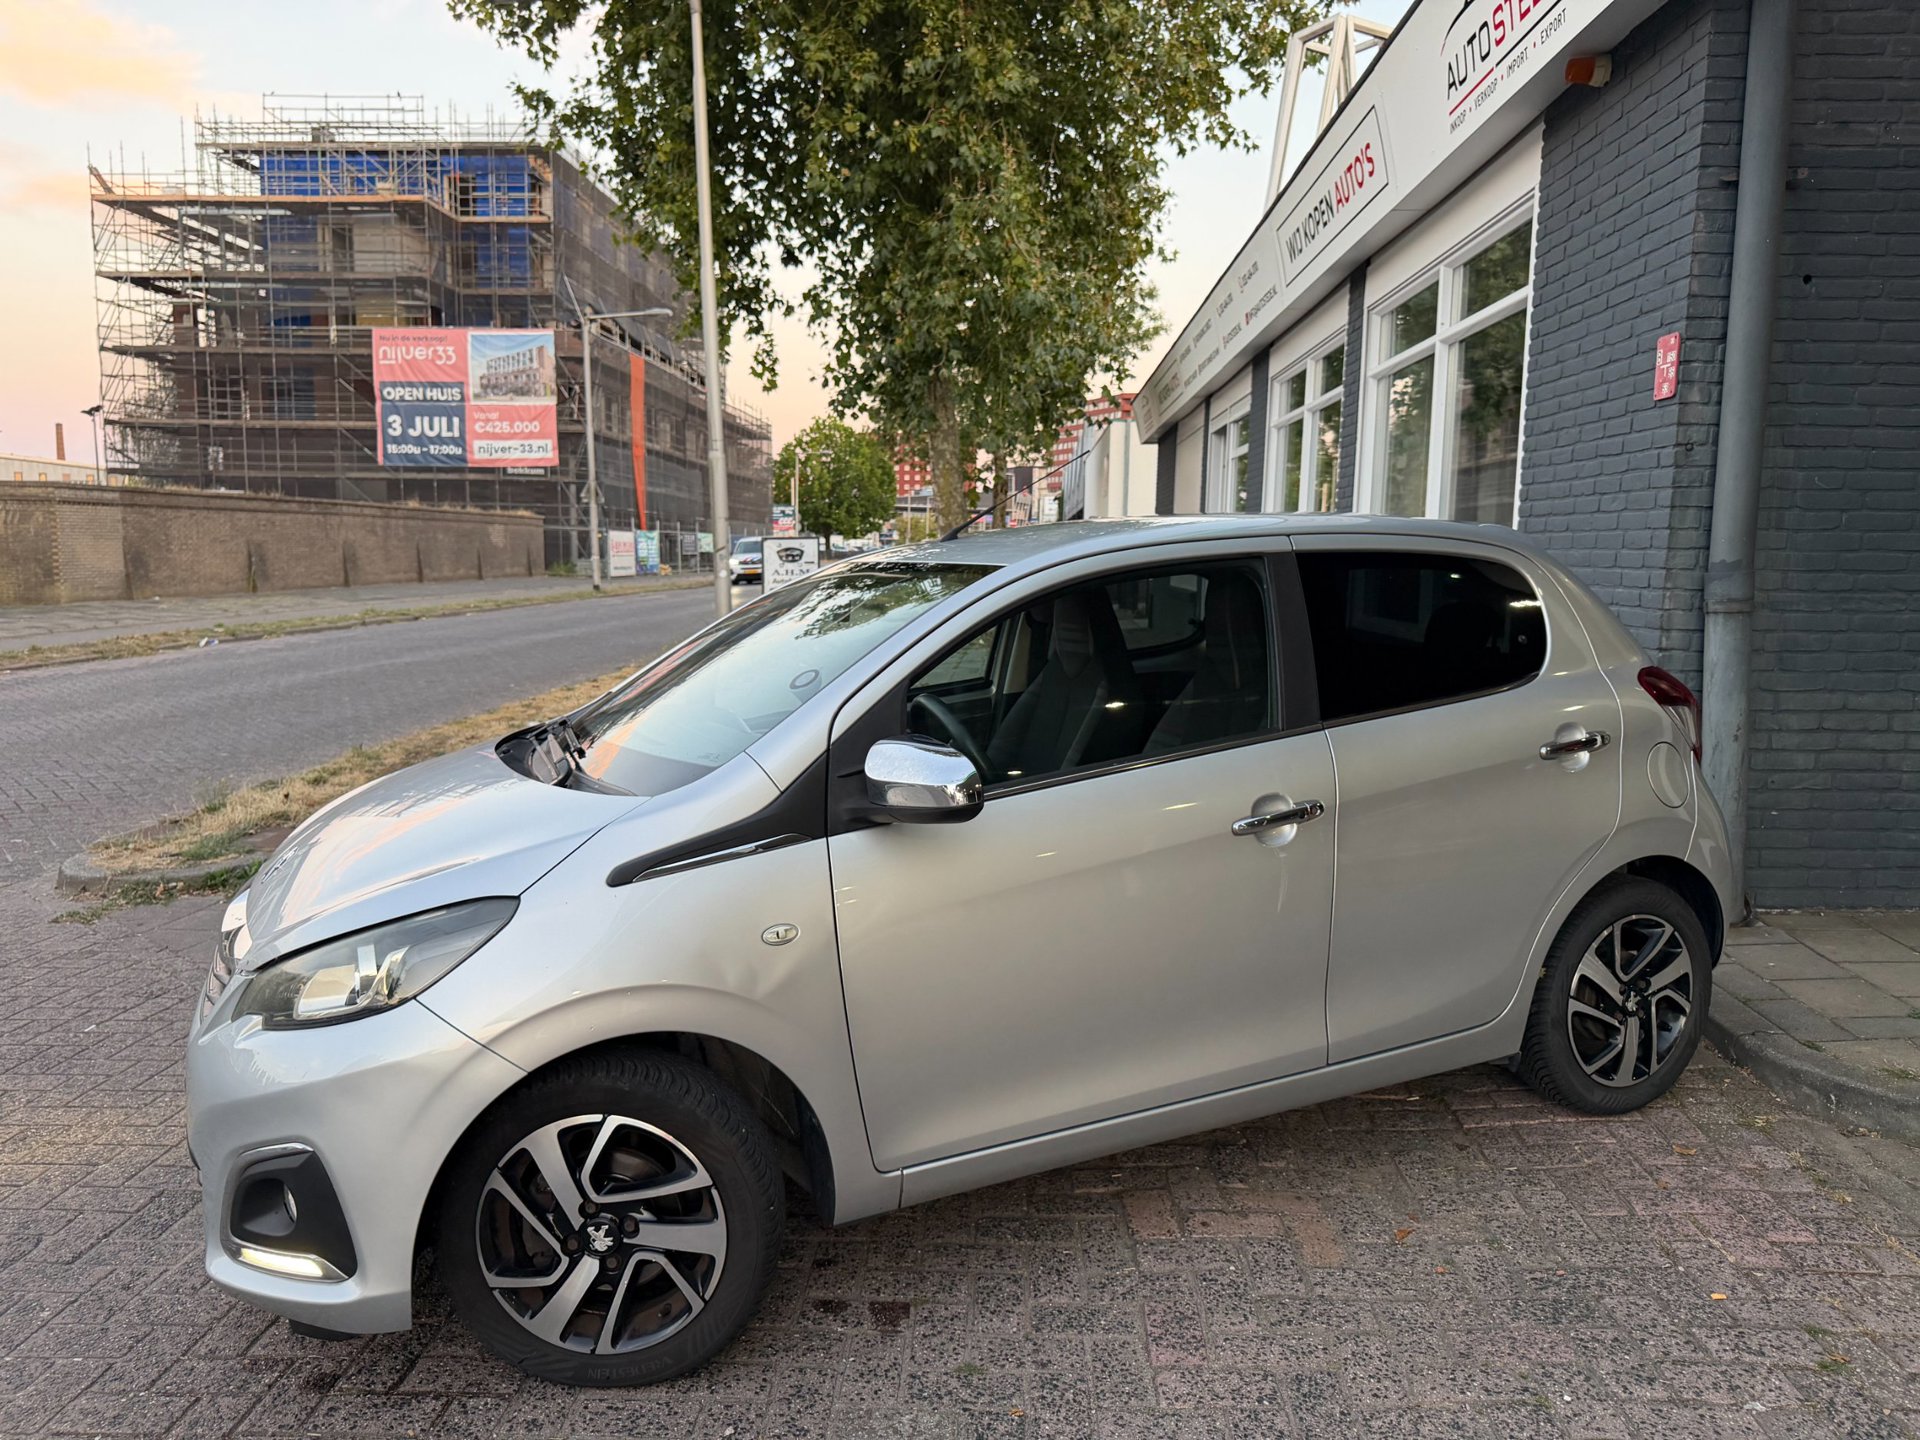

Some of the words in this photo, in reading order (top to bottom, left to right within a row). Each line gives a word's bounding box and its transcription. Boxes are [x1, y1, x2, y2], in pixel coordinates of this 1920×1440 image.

[1447, 0, 1542, 100] AUTOSTE
[1473, 77, 1498, 110] VERKOOP
[1506, 46, 1528, 78] IMPORT
[1540, 8, 1566, 45] EXPORT
[1302, 189, 1335, 248] KOPEN
[1334, 142, 1375, 213] AUTO'S
[383, 387, 424, 401] OPEN
[426, 387, 462, 401] HUIS
[387, 414, 403, 437] 3
[407, 415, 460, 438] JULI
[474, 421, 541, 433] €425.000
[478, 443, 549, 457] nijver-33.nl
